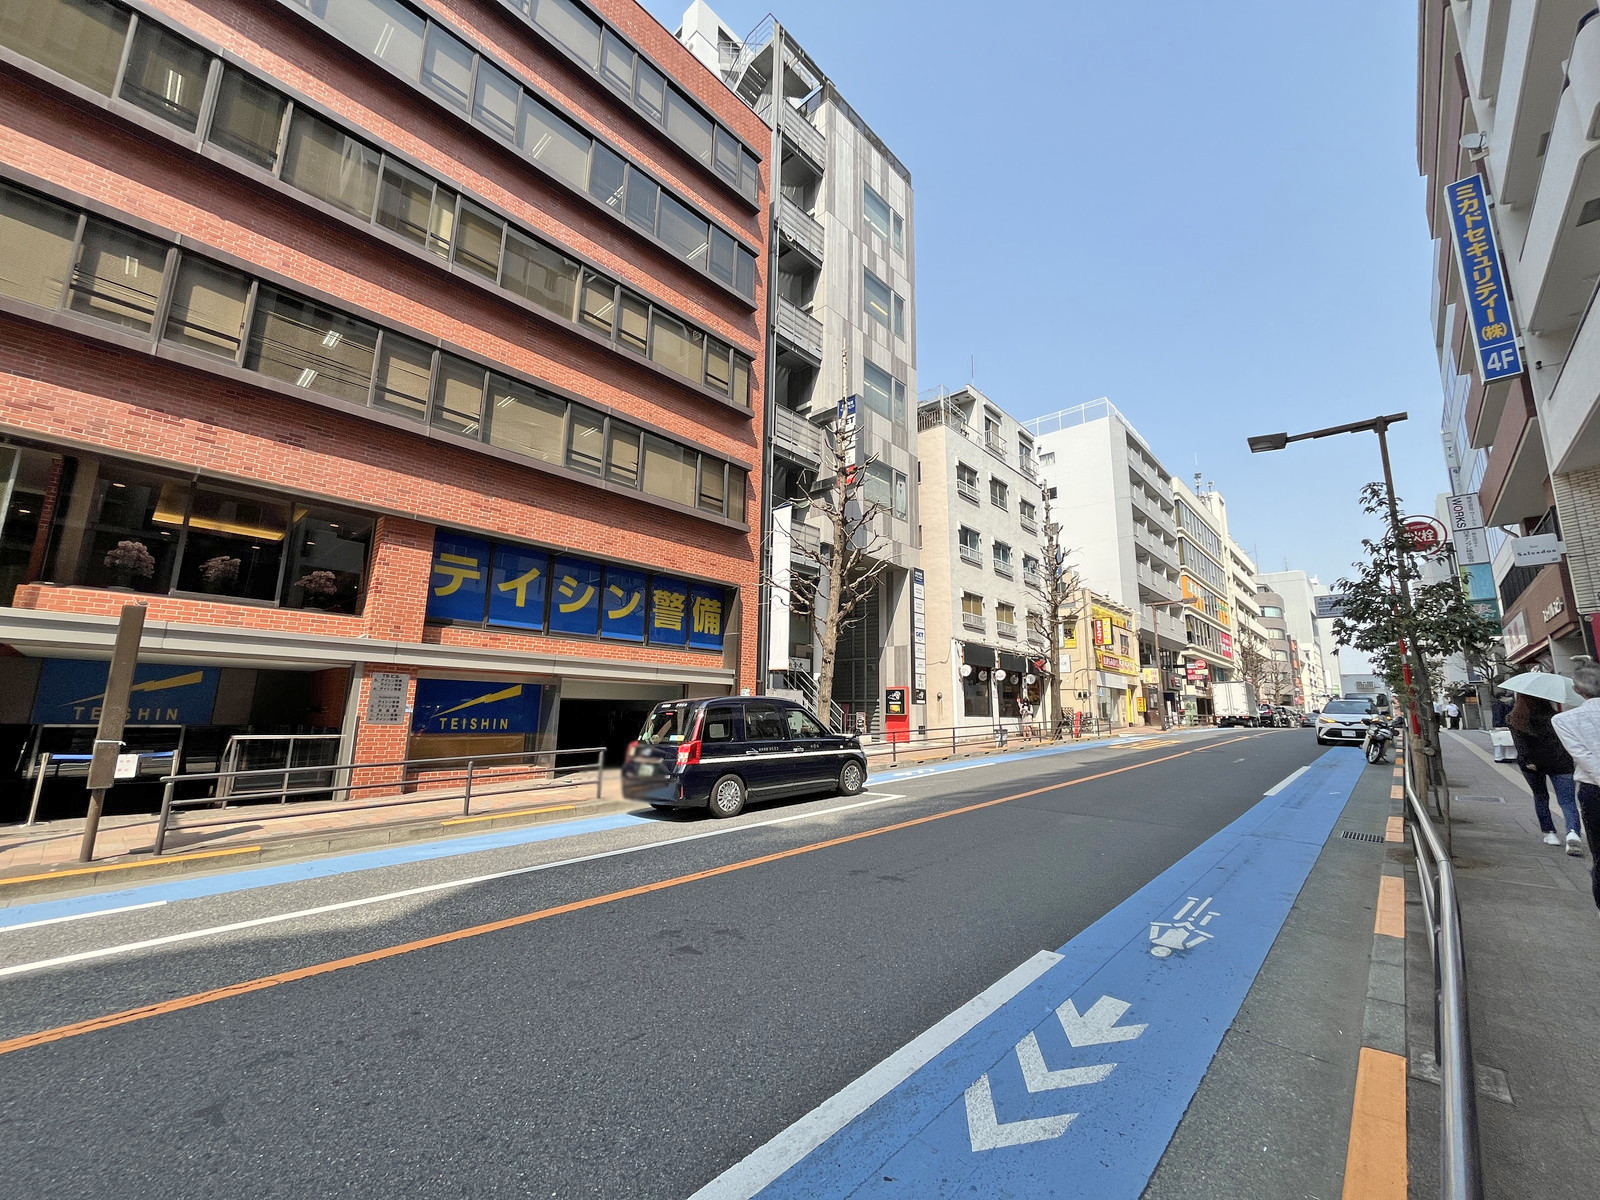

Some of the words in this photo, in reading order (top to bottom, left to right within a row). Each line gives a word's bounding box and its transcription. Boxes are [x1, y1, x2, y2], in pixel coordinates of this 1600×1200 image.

[1456, 183, 1507, 341] ミカドセキュリティー(株)
[1486, 349, 1515, 372] 4F
[1452, 497, 1467, 529] WORKS
[433, 553, 722, 636] テイシン警備
[73, 706, 179, 720] TEHIN
[439, 717, 509, 730] TEISHIN
